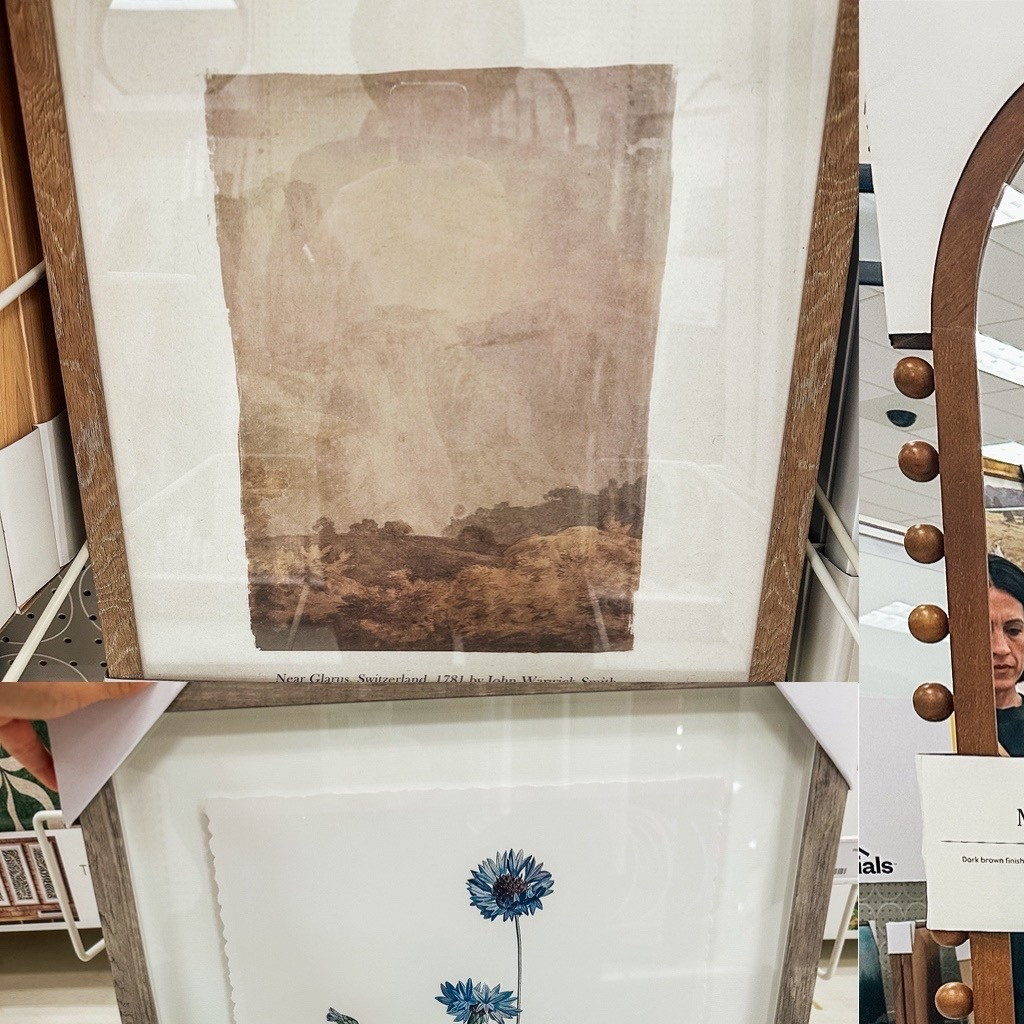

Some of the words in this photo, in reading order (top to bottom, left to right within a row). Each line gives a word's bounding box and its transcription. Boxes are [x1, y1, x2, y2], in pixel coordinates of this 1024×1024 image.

[276, 673, 306, 683] Near
[437, 674, 465, 683] 1781
[980, 856, 1004, 864] brown
